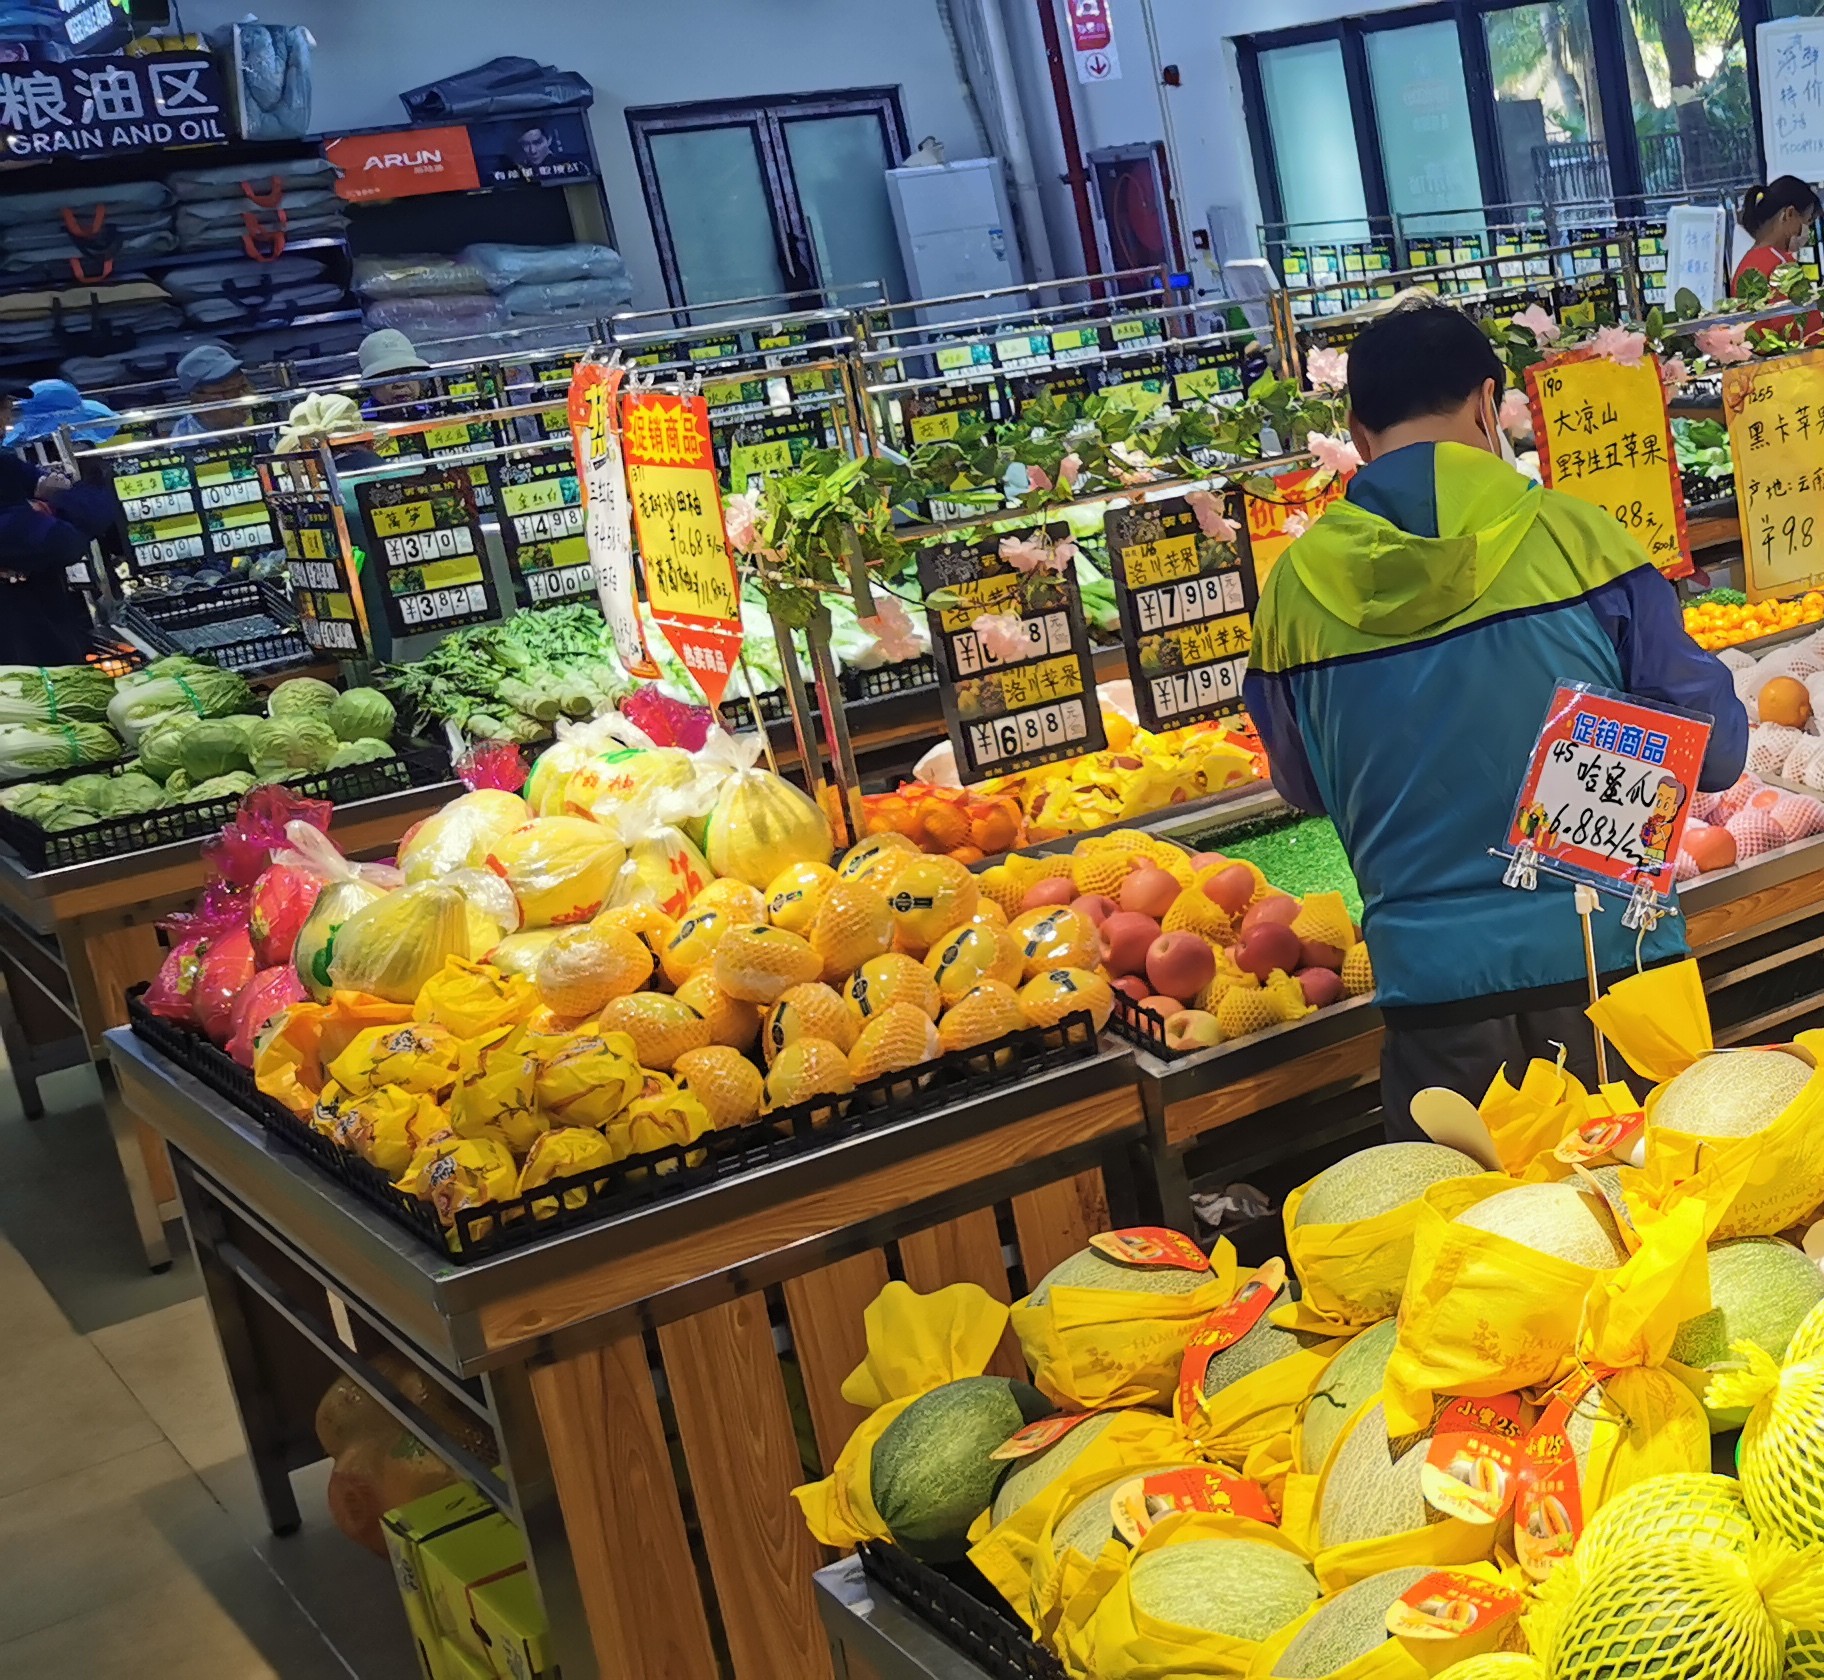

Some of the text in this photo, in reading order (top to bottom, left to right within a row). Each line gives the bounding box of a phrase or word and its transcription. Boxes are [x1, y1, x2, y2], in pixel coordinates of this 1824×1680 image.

[0, 61, 218, 130] 粮油区
[9, 119, 225, 154] GRAIN AND OIL
[363, 149, 442, 171] ARUN
[633, 410, 699, 457] 促销商品
[1553, 400, 1618, 438] 大凉山
[1128, 547, 1198, 584] 洛川苹果
[1571, 711, 1670, 766] 促销商品
